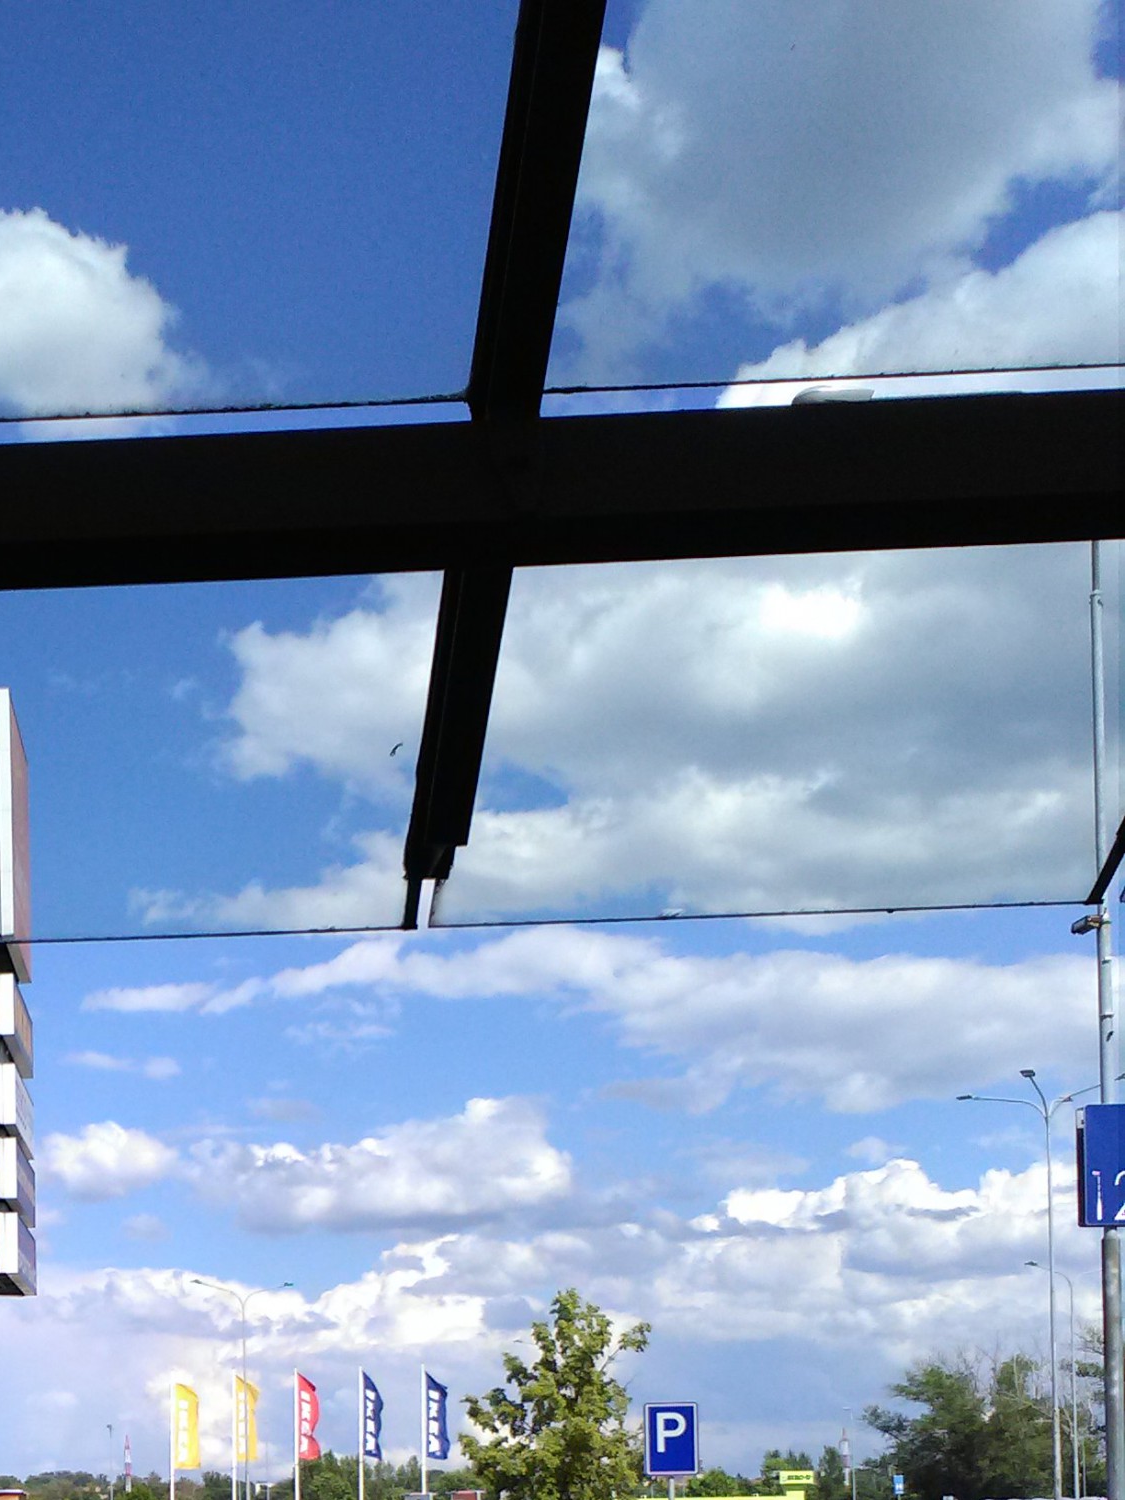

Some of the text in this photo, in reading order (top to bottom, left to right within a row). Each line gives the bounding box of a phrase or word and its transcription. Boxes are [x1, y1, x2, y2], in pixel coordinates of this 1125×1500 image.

[300, 1390, 312, 1453] IKEA
[365, 1388, 376, 1451] IKEA
[428, 1389, 440, 1452] IKEA
[656, 1412, 685, 1453] P
